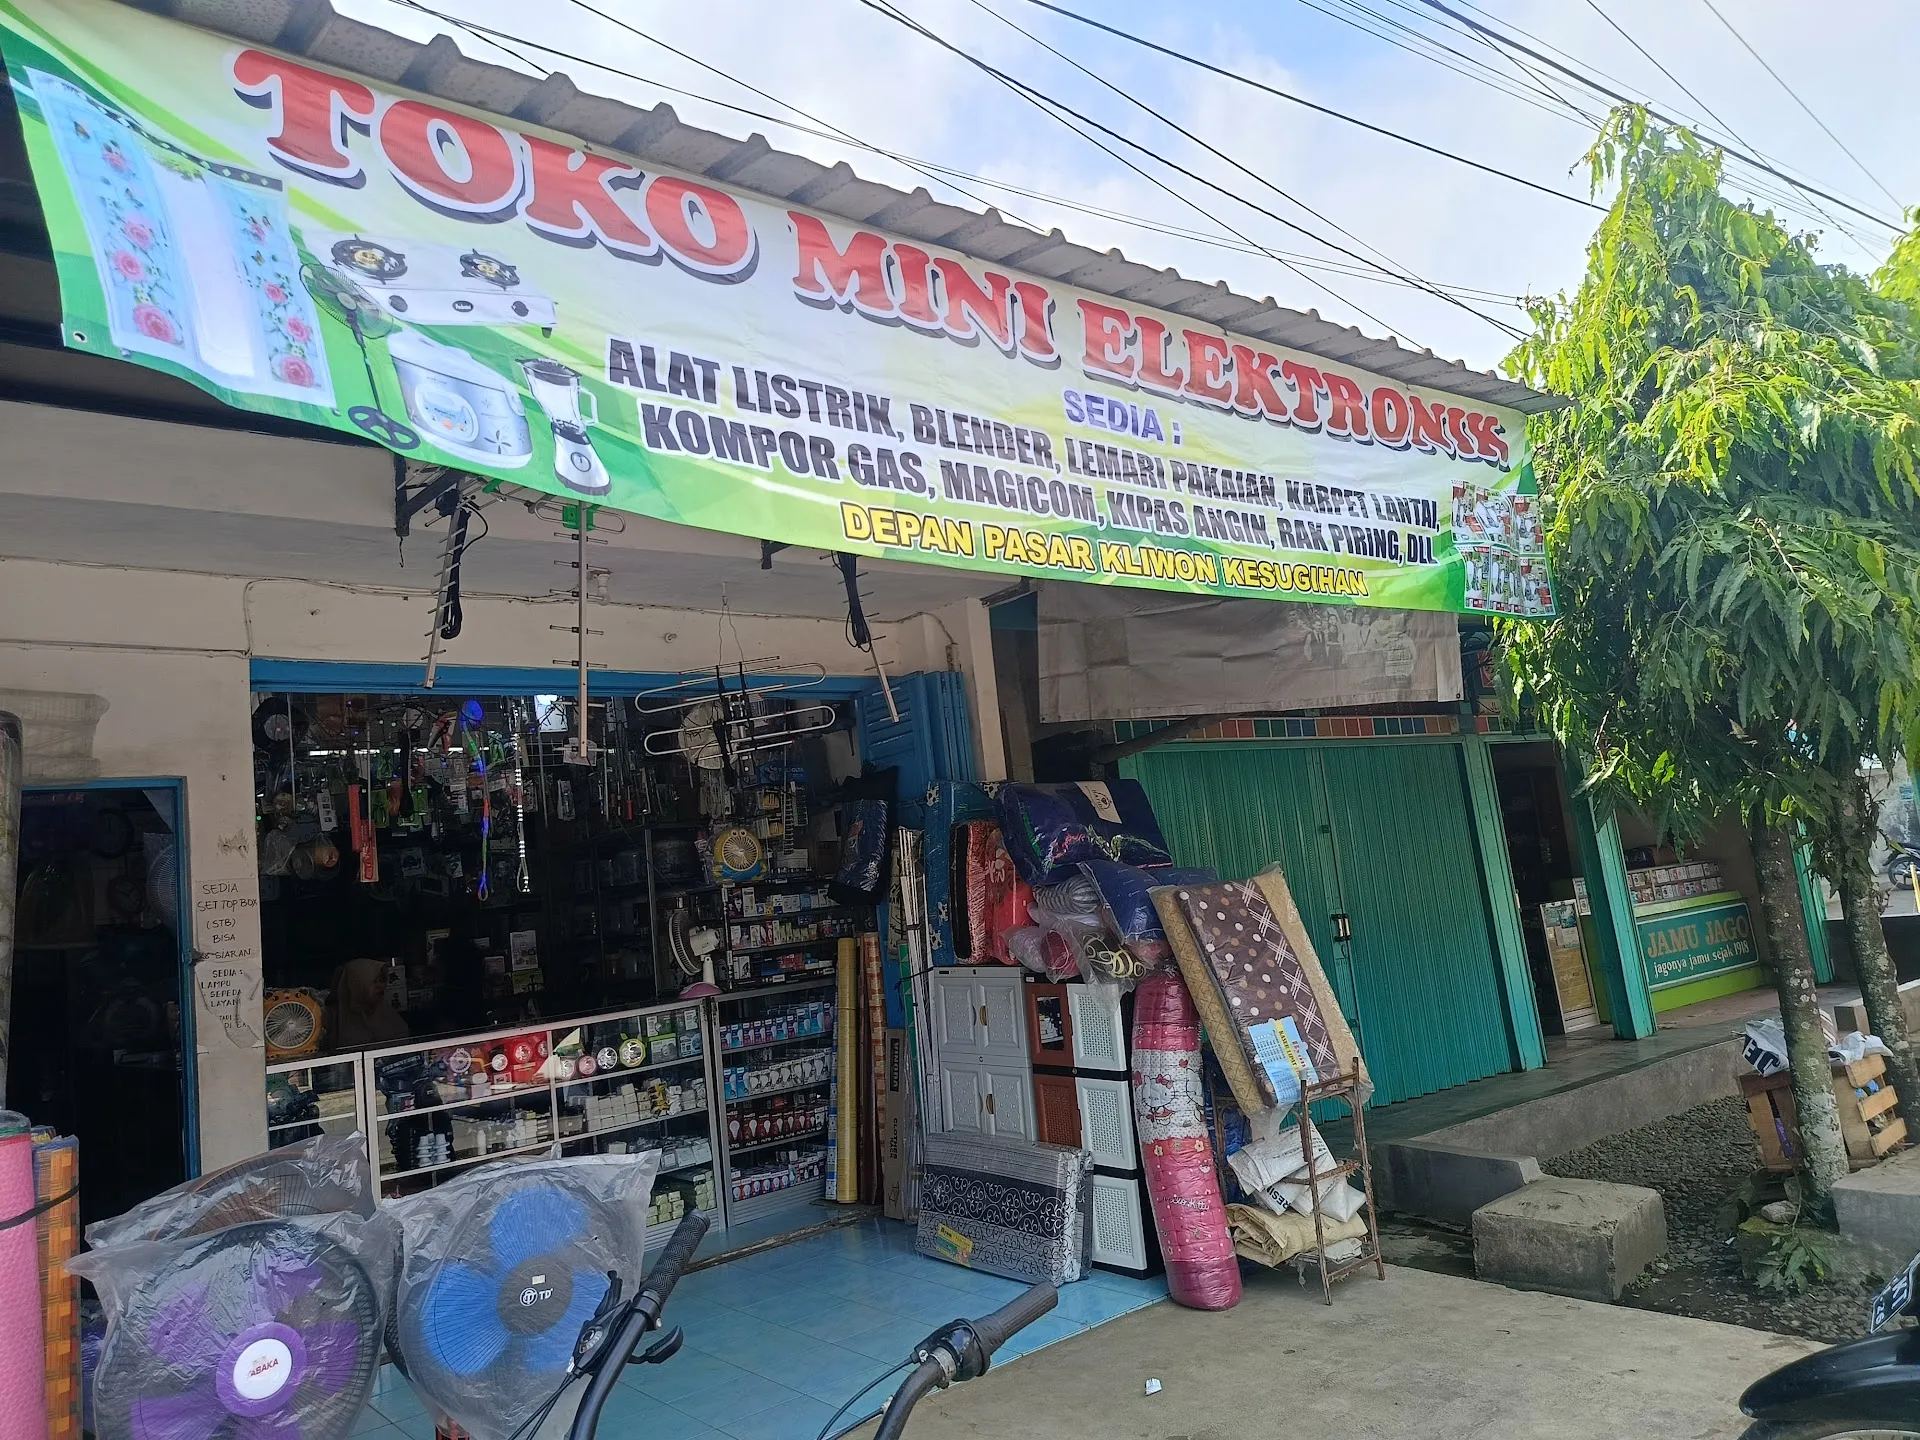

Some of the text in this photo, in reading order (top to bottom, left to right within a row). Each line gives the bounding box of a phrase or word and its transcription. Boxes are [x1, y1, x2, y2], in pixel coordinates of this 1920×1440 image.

[232, 49, 1510, 470] TOKO MINI ELEKTRONIK
[1063, 390, 1164, 442] SEDIA
[608, 337, 721, 404] ALAT
[733, 366, 903, 443] LISTRIK,
[910, 402, 1061, 474] BLENDER,
[1064, 436, 1168, 490] LEMARI
[1170, 459, 1284, 511] PAKAIAN,
[1285, 479, 1370, 519] KARPET
[1370, 493, 1440, 533] LANTAI,
[640, 403, 1439, 565] KOMPOR GAS, MAGICOM, KIPAS ANGIN, RAK PIRING, DLL
[840, 501, 1369, 599] DEPAN PASAR KLIWON KESUGIHAN
[202, 882, 239, 895] SEDIA
[197, 898, 258, 913] SET TOP BOX
[206, 918, 236, 930] (STB)
[1647, 914, 1749, 958] JAMU JAGO
[212, 934, 236, 944] BISA
[1653, 940, 1750, 978] jagonya jamu sejak 1918
[201, 980, 231, 989] LAMPU
[212, 969, 238, 978] SEDIA
[210, 989, 242, 998] SEPEDA
